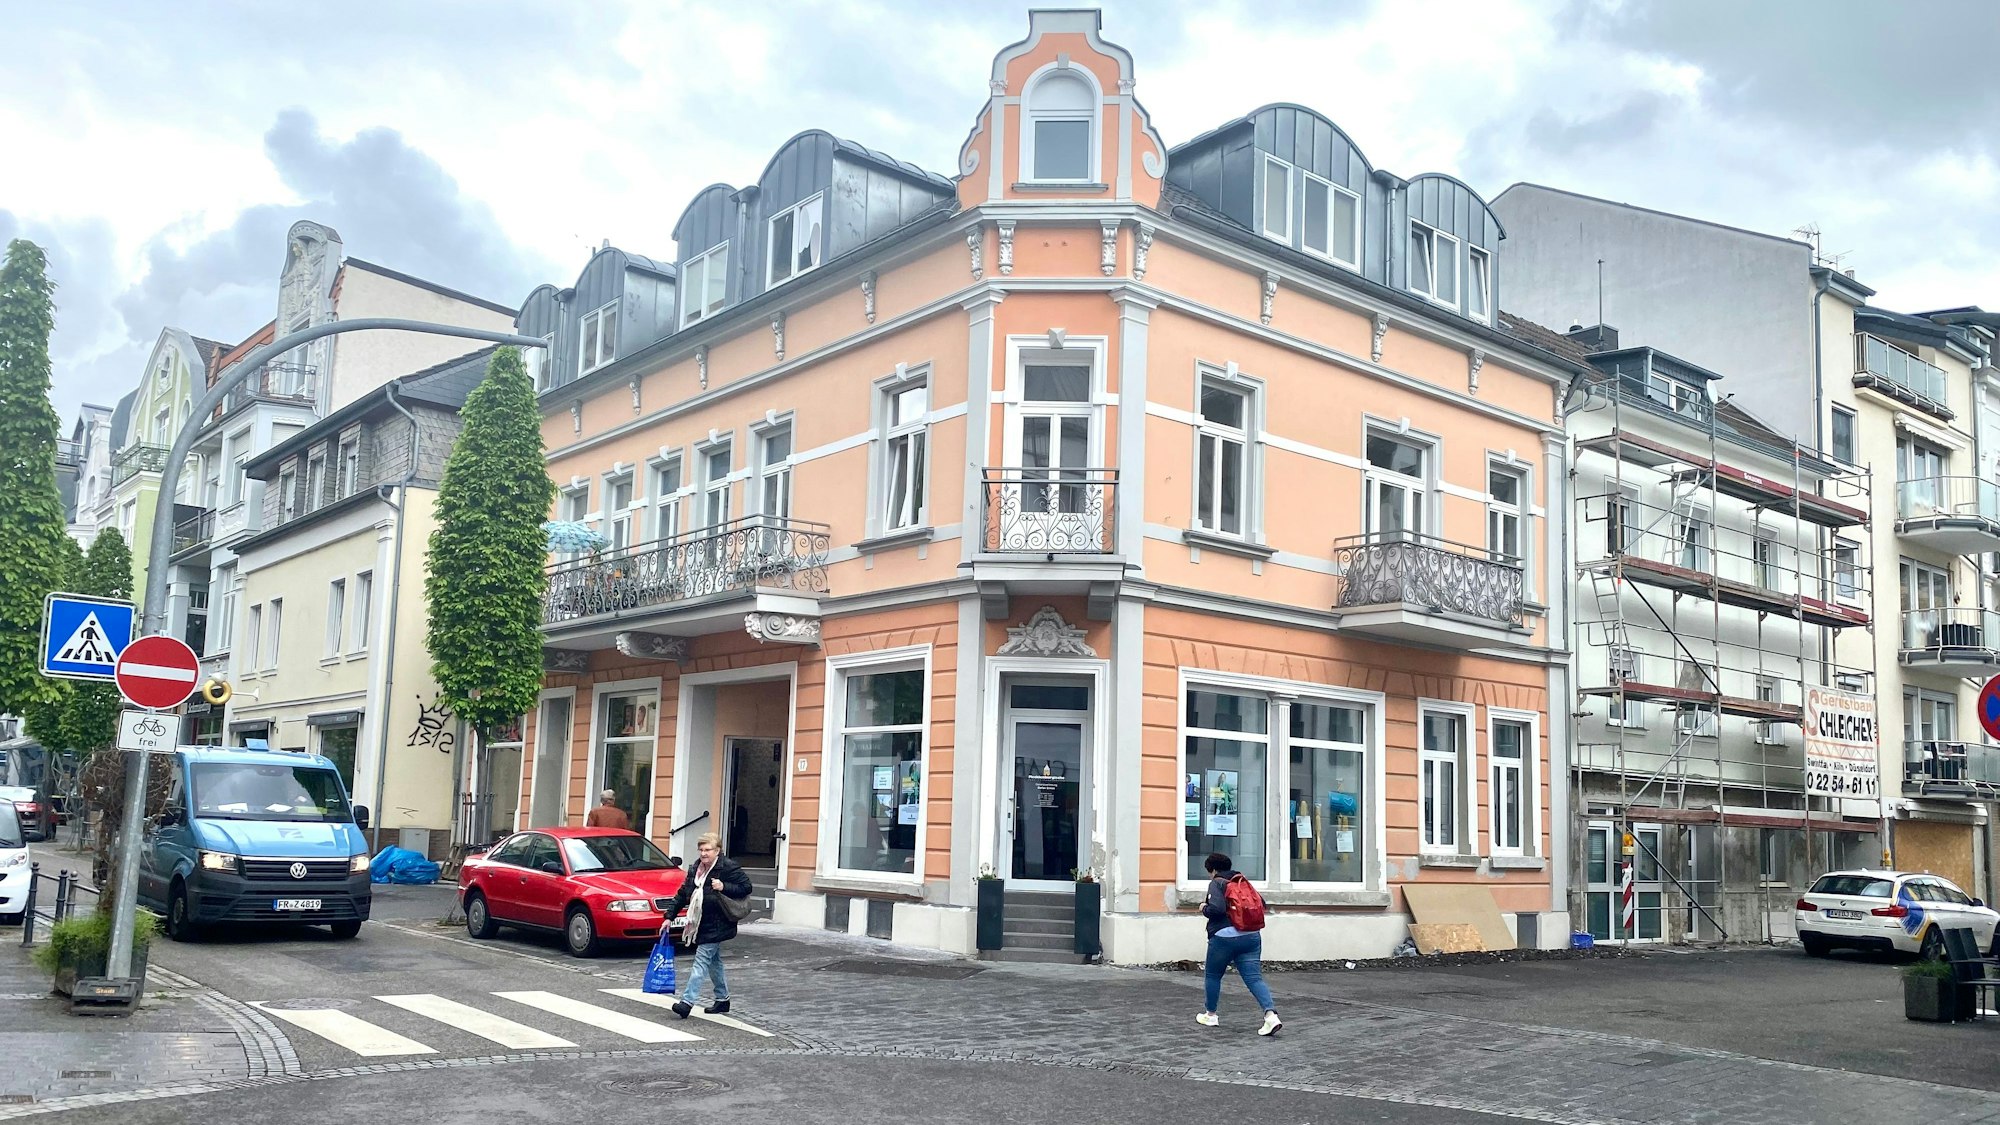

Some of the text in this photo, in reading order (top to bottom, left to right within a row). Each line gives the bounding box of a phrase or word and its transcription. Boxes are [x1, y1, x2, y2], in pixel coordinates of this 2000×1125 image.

[138, 737, 158, 747] frei
[1807, 771, 1814, 790] 0
[1816, 773, 1829, 791] 22
[1831, 775, 1844, 793] 54
[1852, 776, 1862, 795] 61
[1865, 777, 1876, 795] 11
